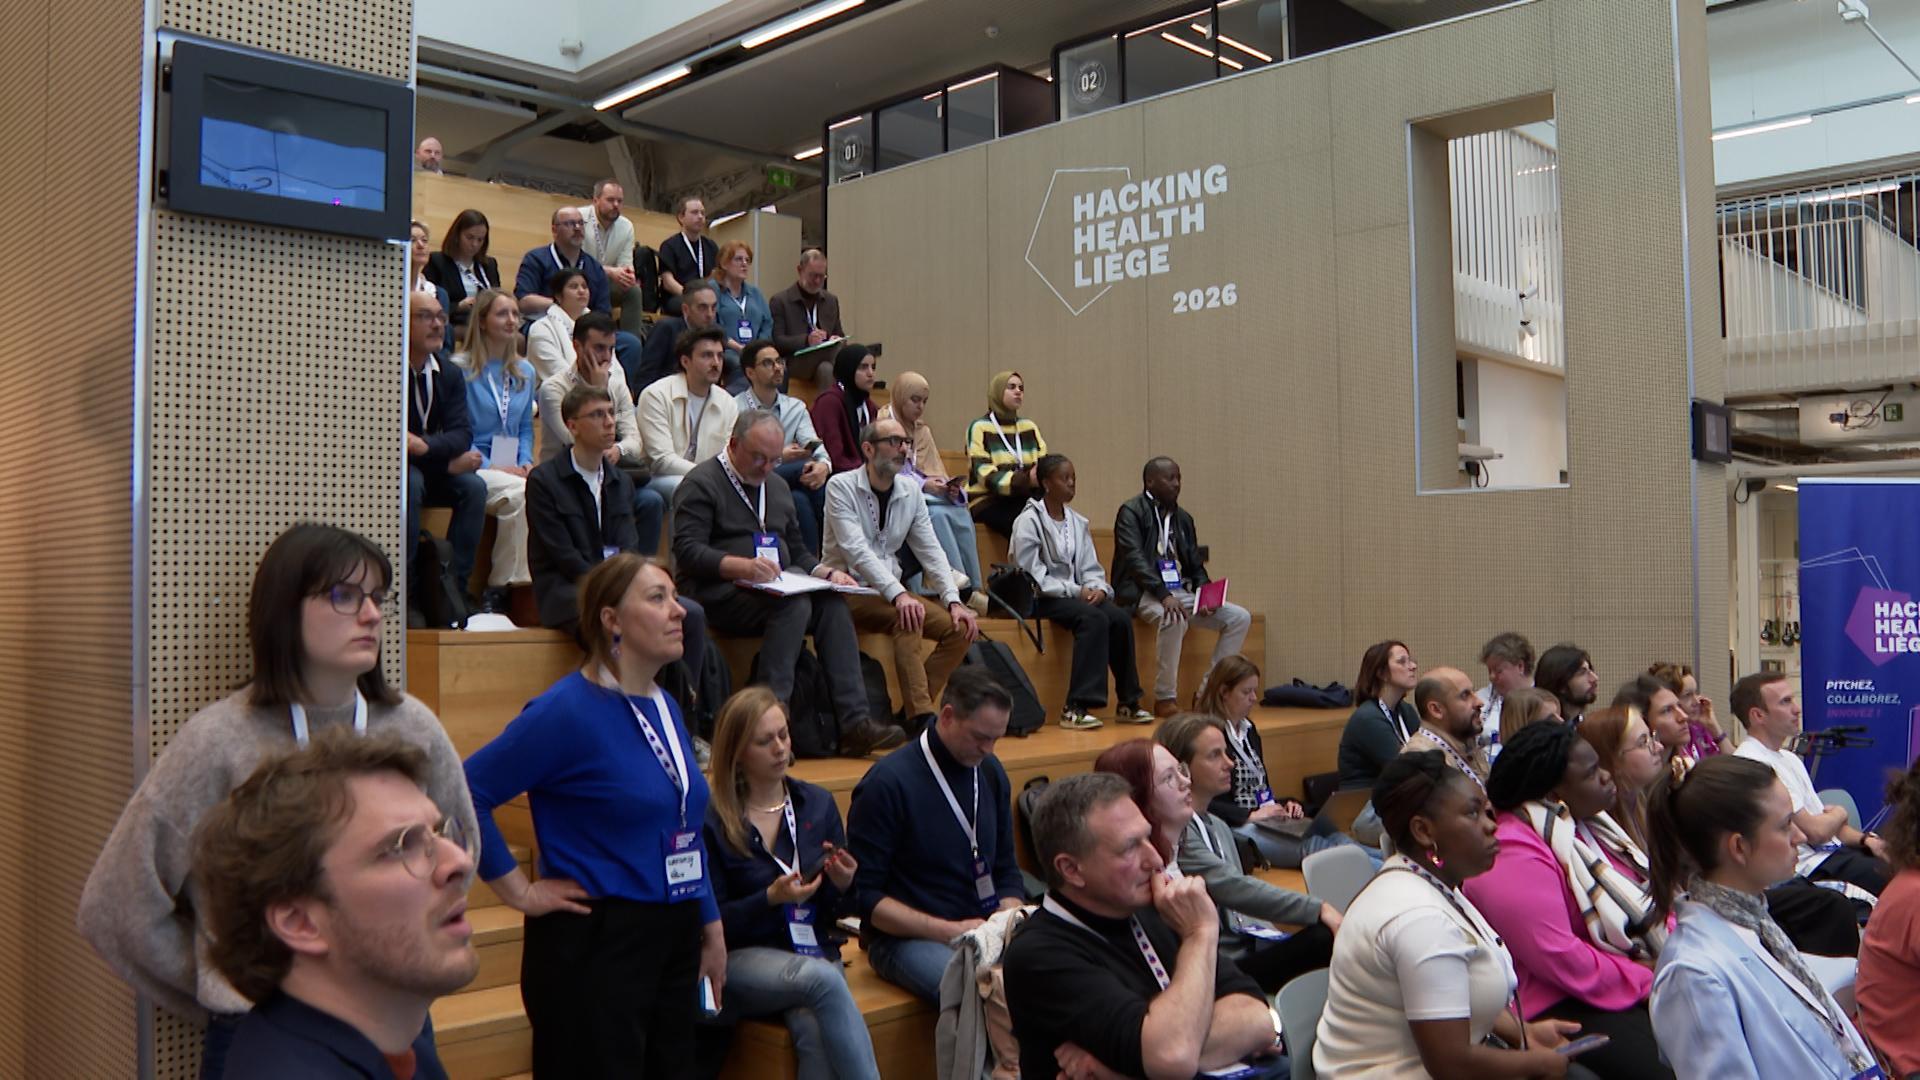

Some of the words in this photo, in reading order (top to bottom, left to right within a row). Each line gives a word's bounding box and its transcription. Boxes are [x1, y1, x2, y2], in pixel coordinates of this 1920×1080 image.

[1081, 71, 1097, 92] 02
[844, 143, 856, 160] 01
[1073, 164, 1228, 223] HACKING
[1073, 202, 1205, 255] HEALTH
[1172, 283, 1238, 314] 2026
[1874, 601, 1920, 618] HAC
[1875, 619, 1920, 634] HEA
[1826, 680, 1875, 691] PITCHEZ,
[1826, 694, 1901, 705] COLLABOREZ,
